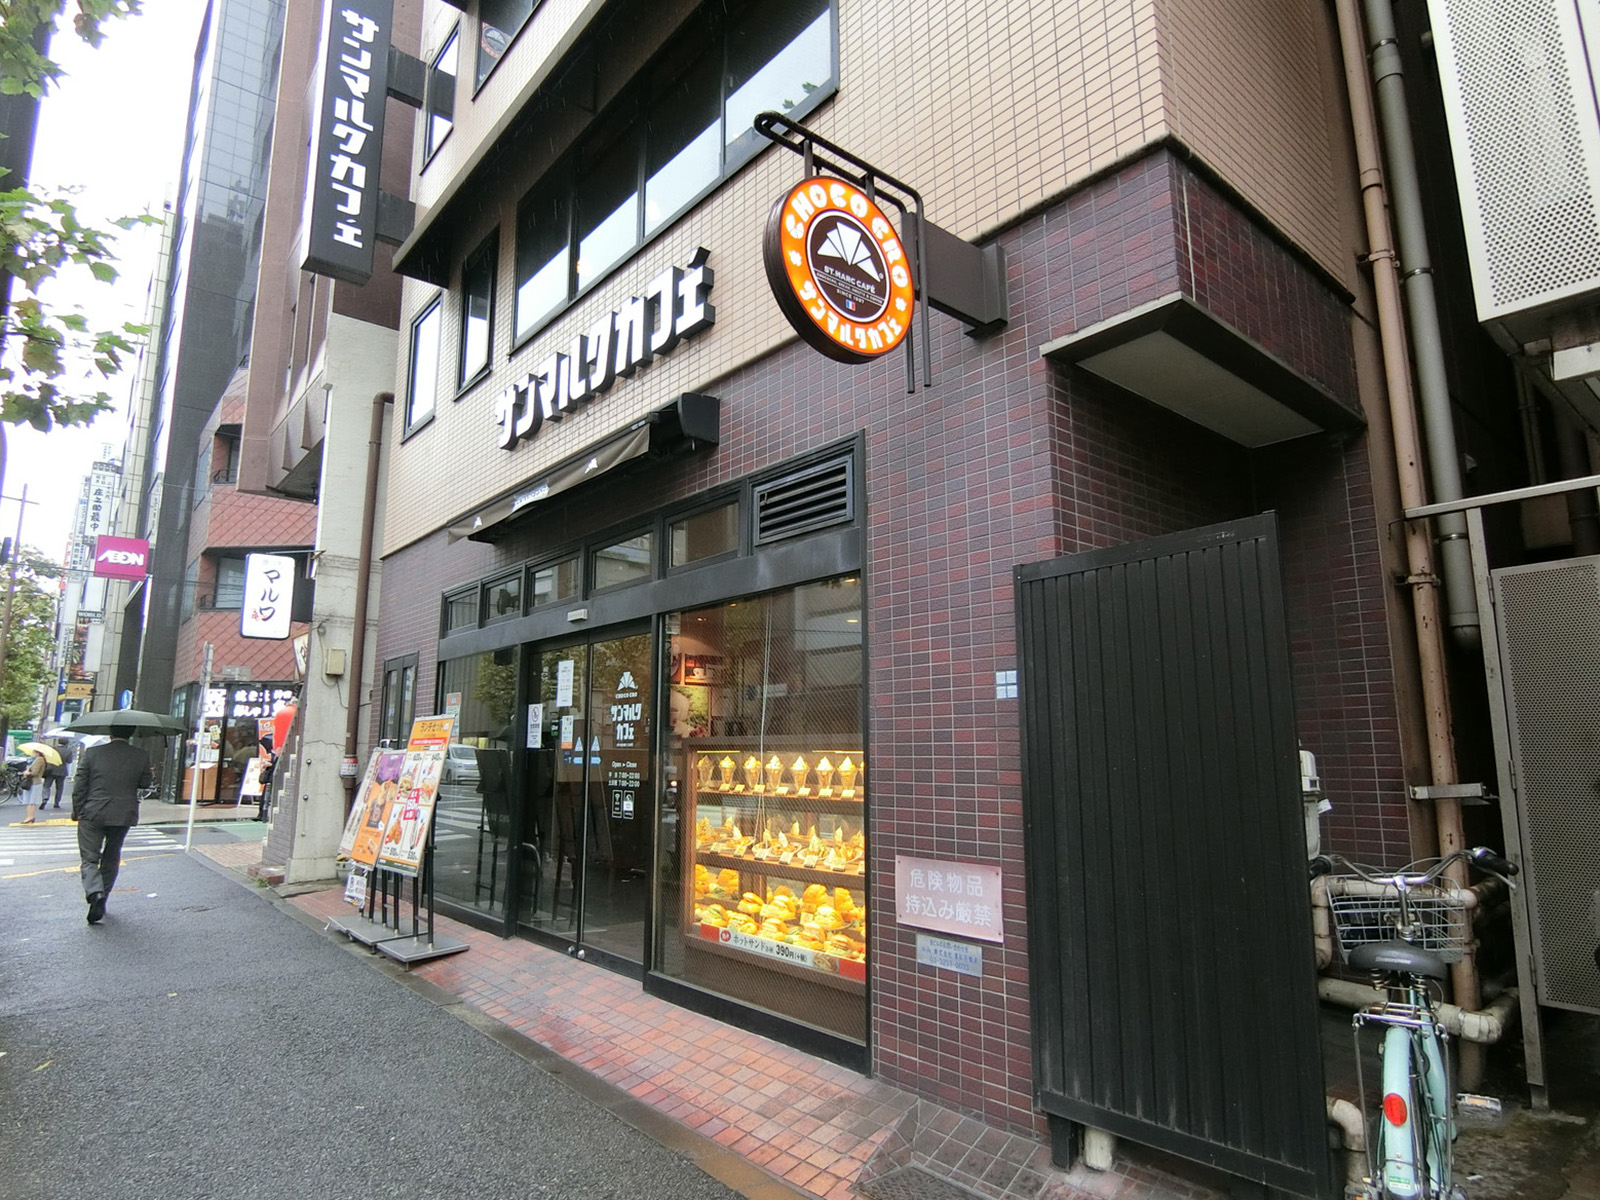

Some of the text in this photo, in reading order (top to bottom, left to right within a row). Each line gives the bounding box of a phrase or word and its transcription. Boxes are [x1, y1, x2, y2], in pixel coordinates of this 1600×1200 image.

[329, 9, 380, 249] サンマルクカフェ
[786, 183, 908, 288] CHOCO CRO
[823, 265, 856, 285] ST.MARC
[799, 281, 902, 349] サンマルクカフェ
[495, 246, 715, 450] サンマルクカフェ
[260, 569, 281, 622] マルワ
[610, 703, 642, 722] サンマルク
[616, 723, 635, 740] カフェ
[910, 868, 984, 898] 危険物品
[905, 893, 992, 927] 持込み厳禁
